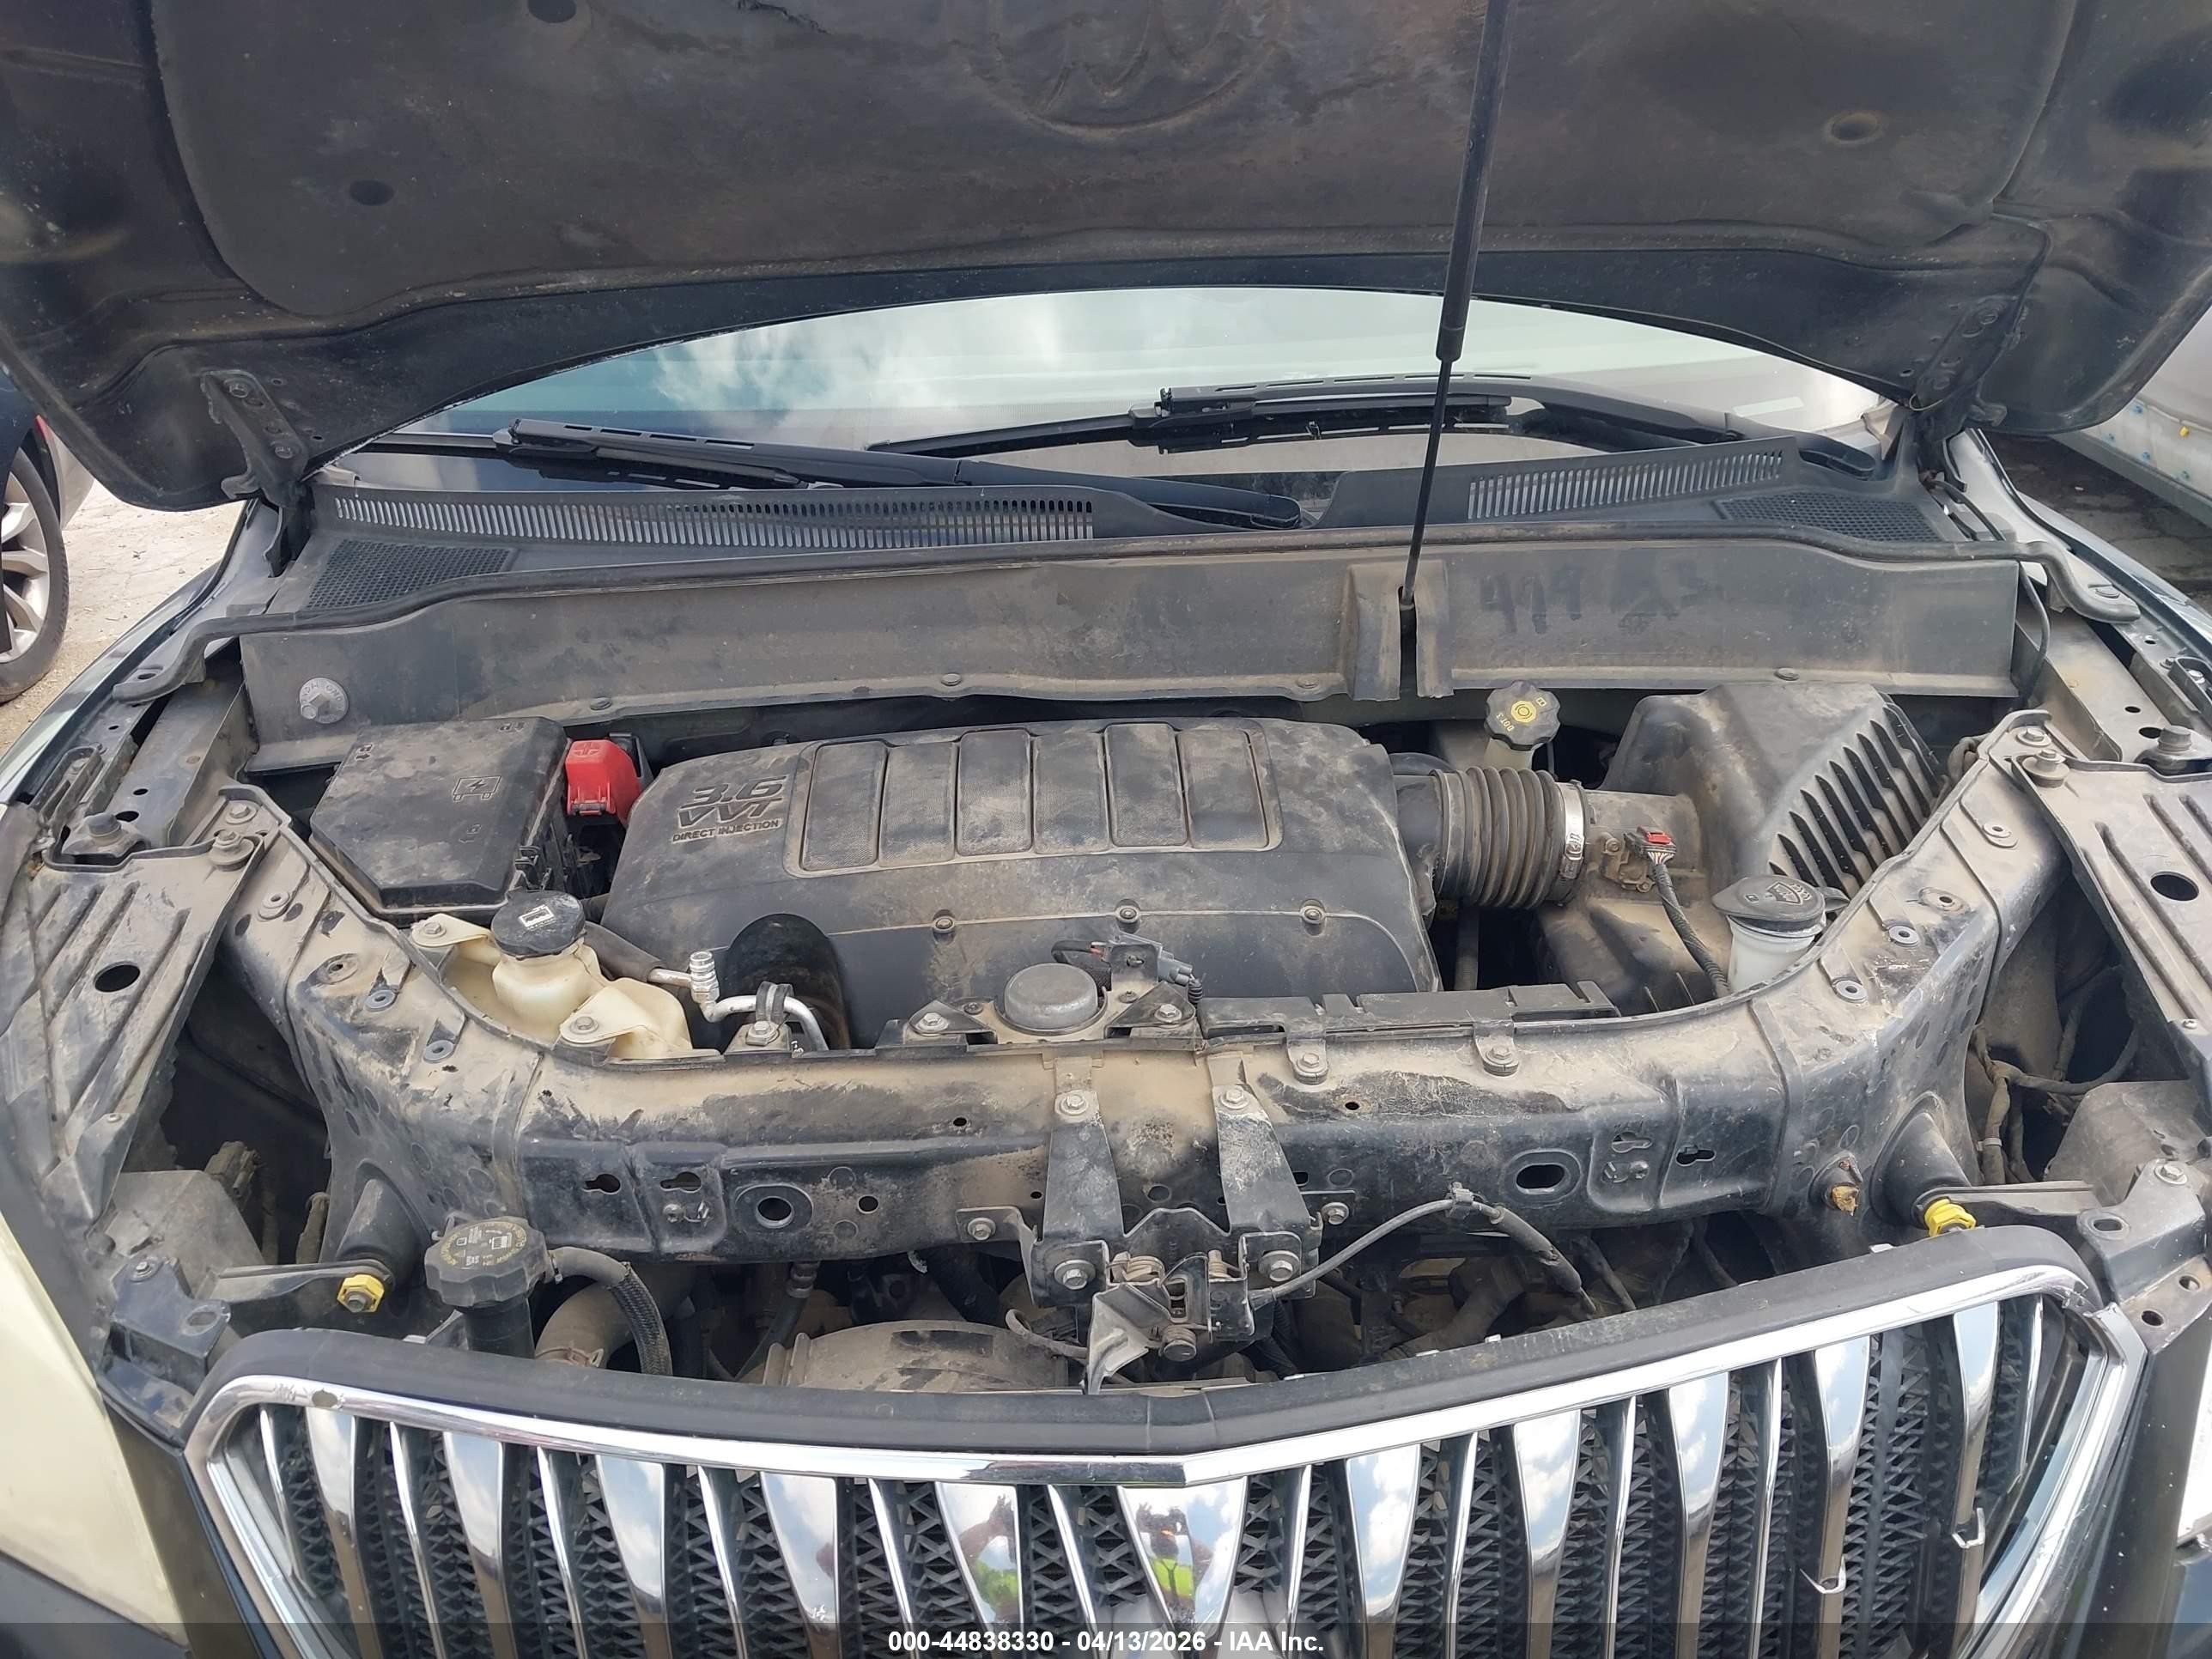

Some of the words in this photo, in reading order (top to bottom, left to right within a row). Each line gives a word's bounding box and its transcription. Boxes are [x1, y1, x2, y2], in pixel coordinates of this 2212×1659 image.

[684, 775, 787, 806] 3.6
[678, 798, 783, 828] VVT
[672, 828, 715, 842] DIRECT
[718, 819, 780, 836] INJECTION
